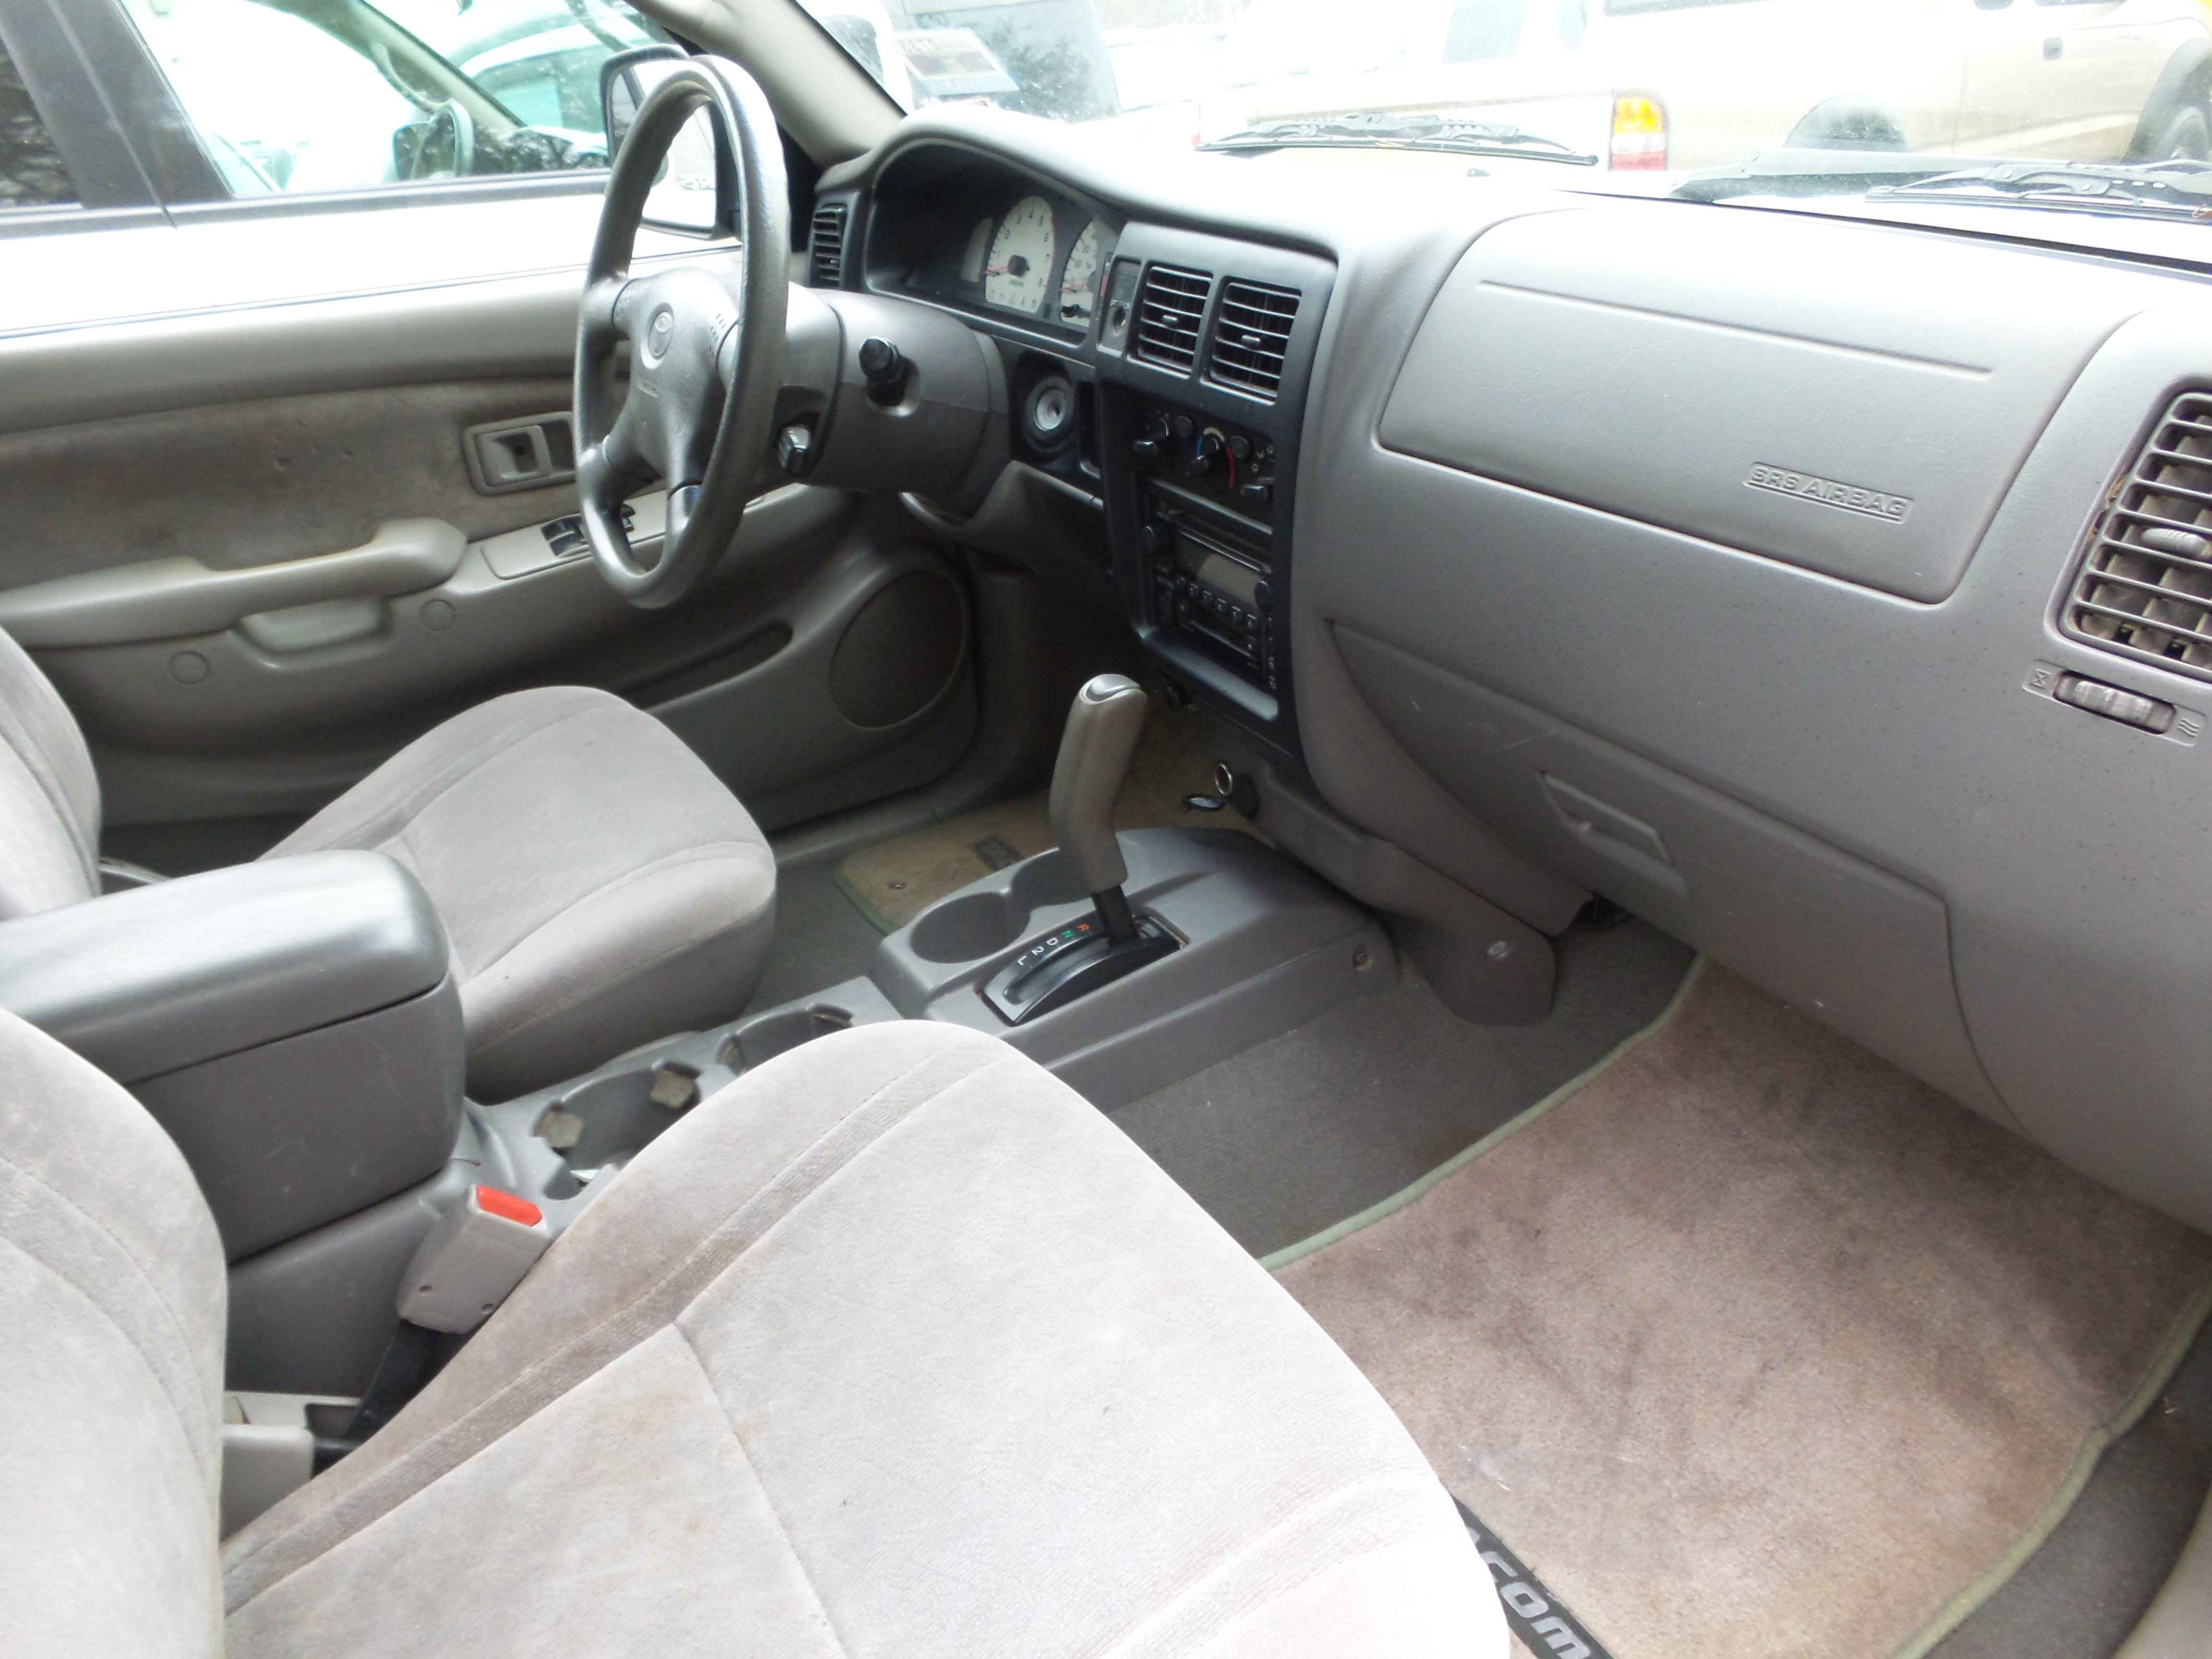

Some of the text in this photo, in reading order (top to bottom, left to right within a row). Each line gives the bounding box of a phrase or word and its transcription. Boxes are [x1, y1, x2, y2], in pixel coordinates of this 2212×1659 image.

[1751, 467, 1907, 516] SRS AIRBAG
[1077, 923, 1090, 932] R
[1062, 930, 1074, 938] N
[1046, 938, 1059, 946] D
[1031, 947, 1044, 955] 2
[1017, 956, 1027, 966] L
